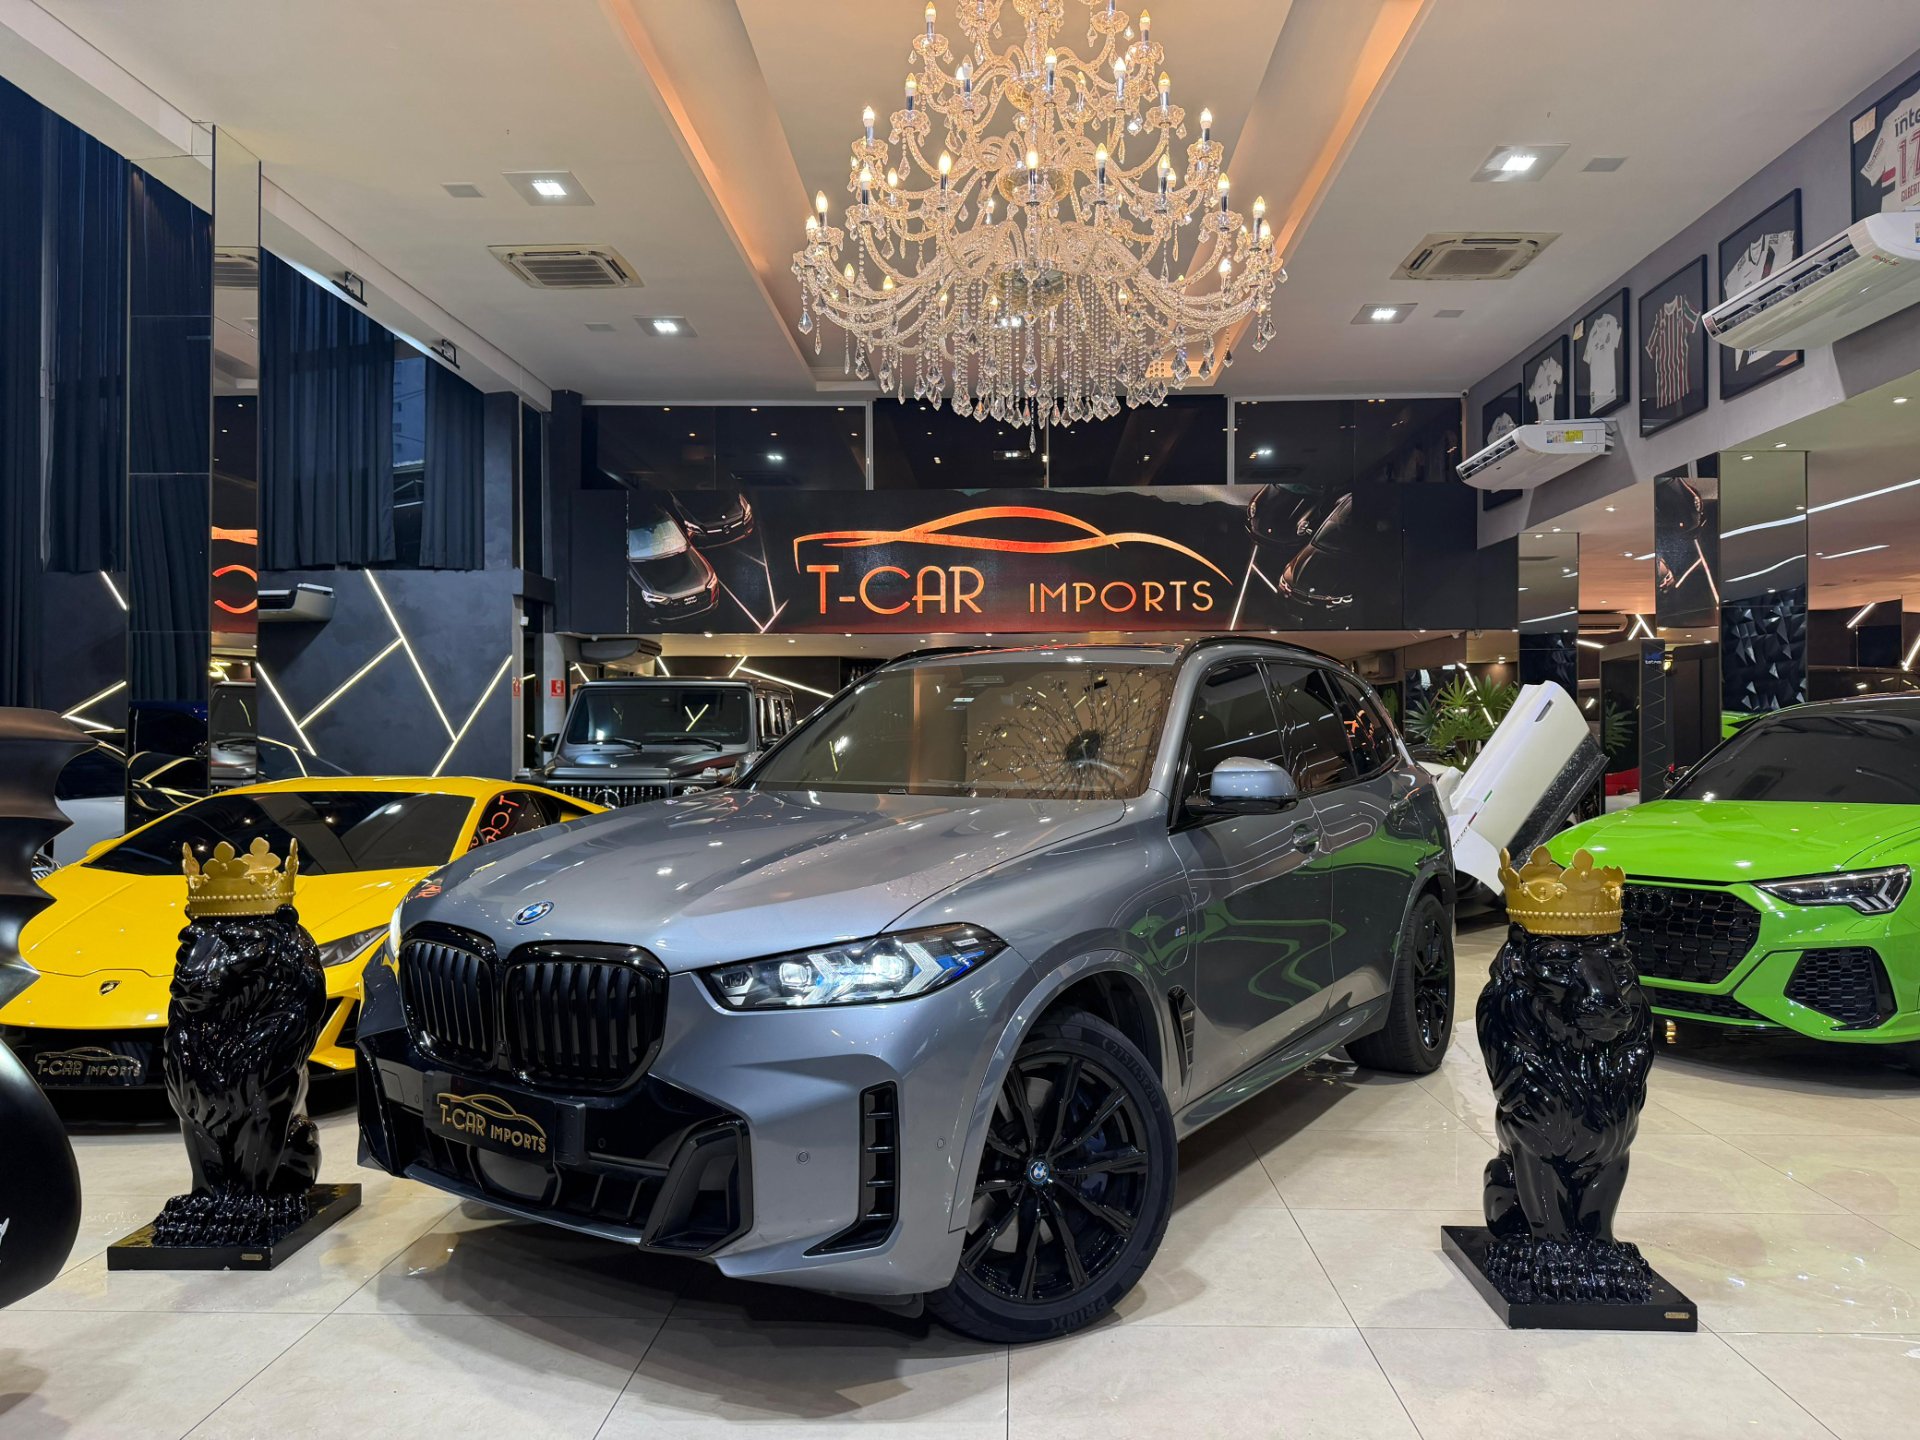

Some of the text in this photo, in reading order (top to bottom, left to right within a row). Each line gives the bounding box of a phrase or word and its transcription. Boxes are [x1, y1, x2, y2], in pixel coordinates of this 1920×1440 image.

[806, 564, 1214, 615] T-CAR IMPORTS
[37, 1060, 141, 1077] T-CAR IMPORTS
[440, 1103, 547, 1153] T-CAR IMPORTS
